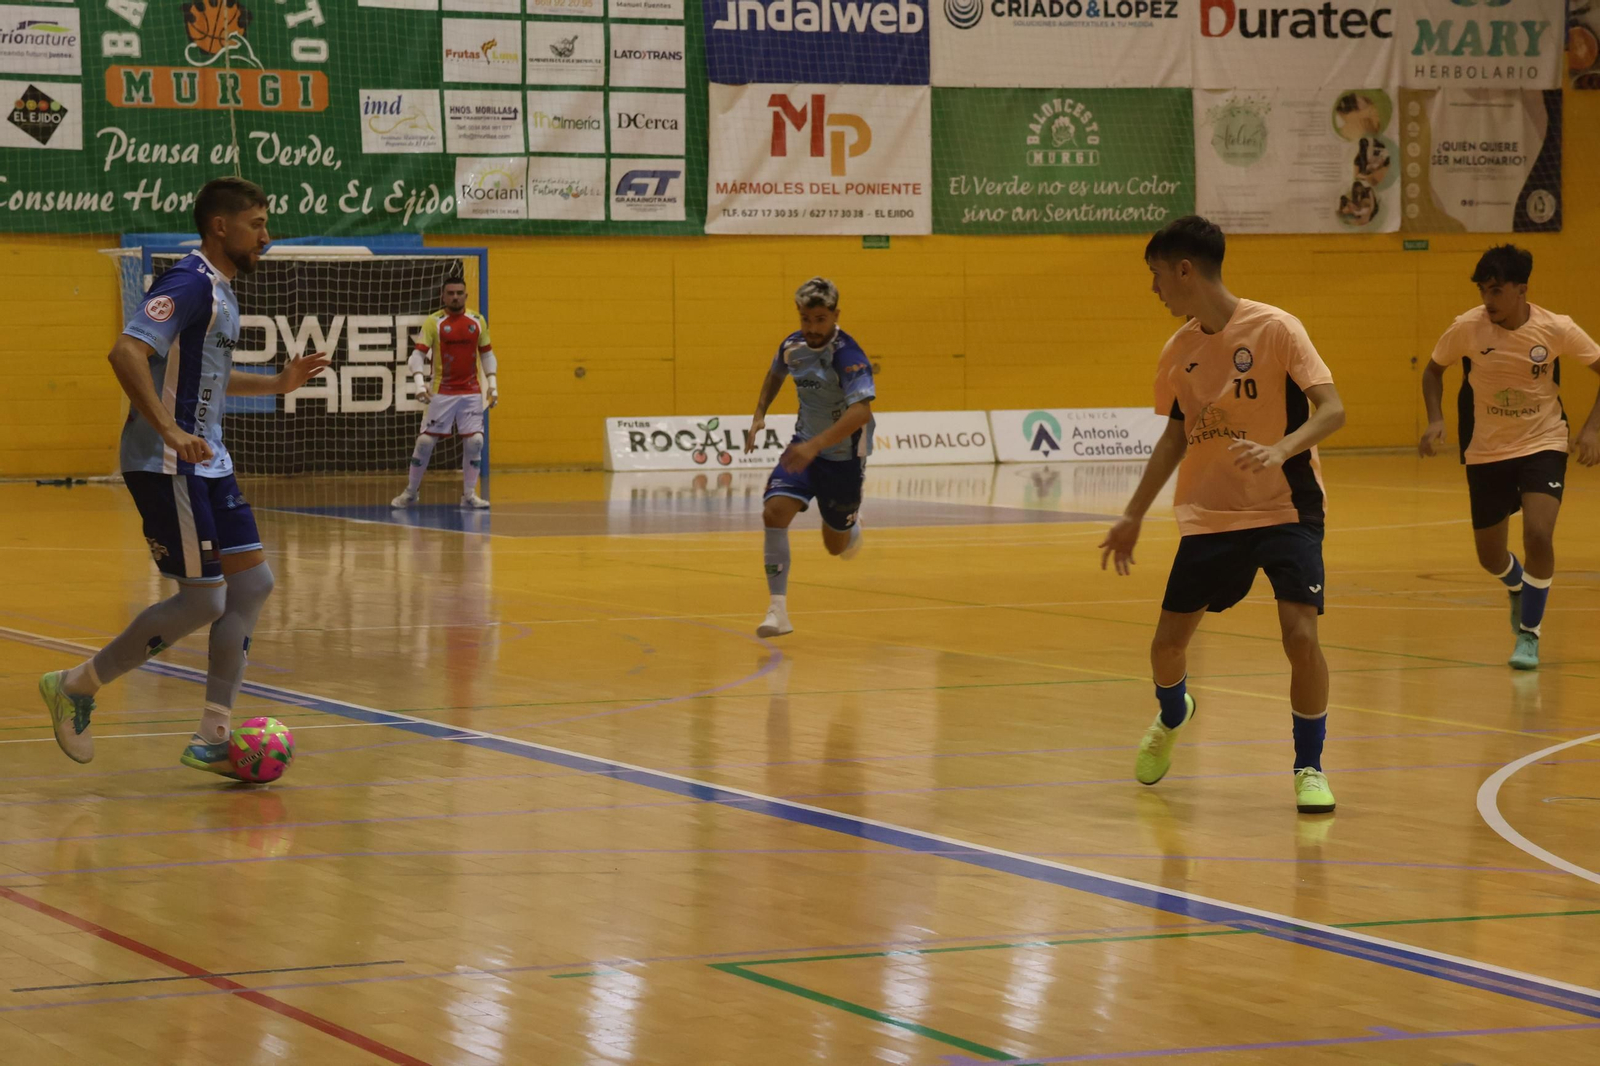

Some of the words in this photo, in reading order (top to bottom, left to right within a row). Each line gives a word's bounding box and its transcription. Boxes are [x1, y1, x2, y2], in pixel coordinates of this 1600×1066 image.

[1200, 0, 1393, 38] Duratec
[1411, 19, 1551, 57] MARY
[445, 48, 480, 59] Frutas
[1414, 65, 1538, 80] HERBOLARIO
[121, 69, 314, 109] MURGI
[363, 94, 403, 115] imd
[475, 106, 513, 115] MORILLAS
[13, 111, 27, 122] EL
[29, 112, 62, 124] EJIDO
[1026, 98, 1100, 145] BALONCESTO
[96, 126, 199, 172] Piensa
[210, 143, 240, 165] en
[248, 131, 343, 171] Verde,
[1479, 142, 1518, 152] QUIERE
[1033, 151, 1094, 164] MURGI
[1431, 155, 1450, 166] SER
[1453, 155, 1527, 166] MILLONARIO?
[461, 184, 524, 200] Rociani
[715, 179, 804, 196] MÁRMOLES
[809, 183, 840, 196] DEL
[845, 182, 923, 196] PONIENTE
[949, 176, 971, 196] El
[973, 175, 1033, 196] Verde
[1037, 179, 1065, 196] no
[1068, 181, 1090, 197] es
[1093, 181, 1124, 196] un
[1126, 175, 1181, 196] Color
[298, 182, 328, 215] de
[338, 179, 374, 215] El
[384, 179, 455, 226] Ejido
[722, 208, 739, 218] TLF.
[741, 208, 758, 218] 627
[761, 208, 771, 218] 17
[809, 208, 827, 218] 627
[875, 208, 885, 218] EL
[887, 208, 914, 218] EJIDO
[961, 204, 1008, 224] sino
[1043, 203, 1170, 223] Sentimiento
[231, 315, 430, 363] OWER
[1232, 378, 1258, 399] 10
[617, 420, 651, 429] Frutas
[1071, 425, 1129, 440] Antonio
[896, 431, 986, 450] HIDALGO
[1188, 427, 1247, 446] OTEPLANT
[1073, 440, 1153, 457] Castañeda
